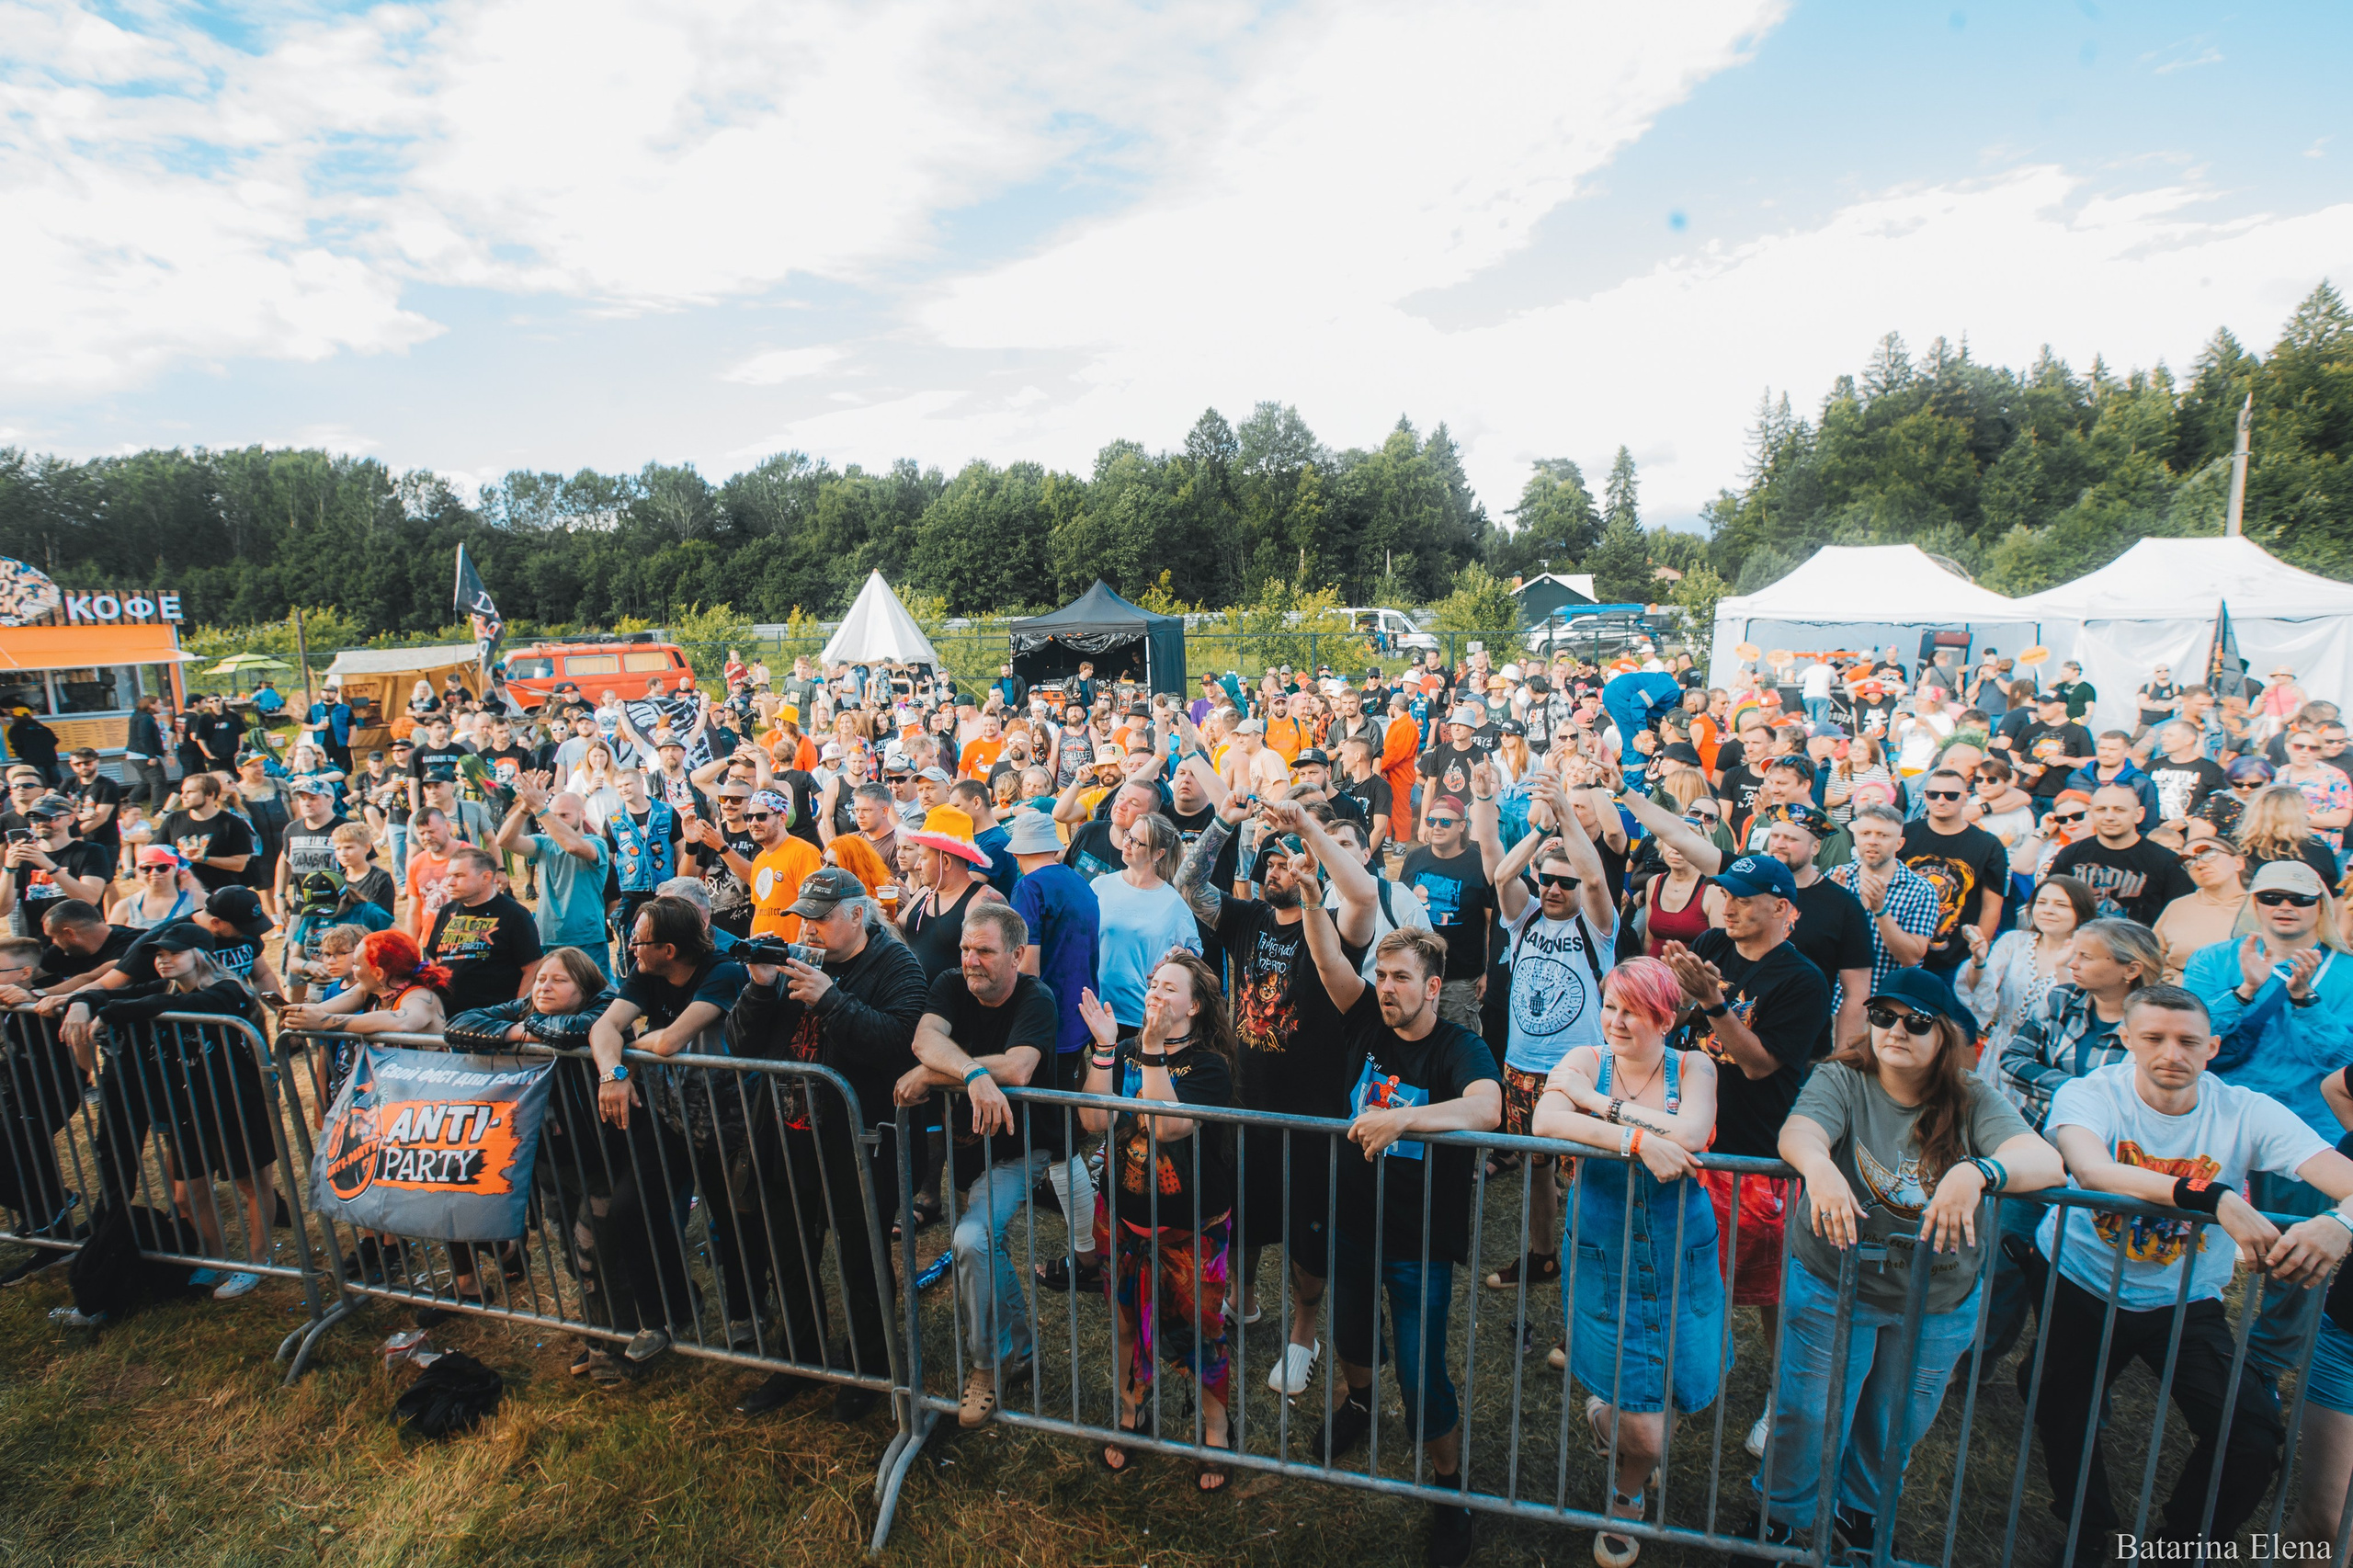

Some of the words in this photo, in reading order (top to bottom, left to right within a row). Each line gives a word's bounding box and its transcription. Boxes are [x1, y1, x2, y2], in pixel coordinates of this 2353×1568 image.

[65, 595, 184, 620] КОФЕ
[1524, 927, 1583, 954] RAMONES
[382, 1148, 478, 1183] PARTY
